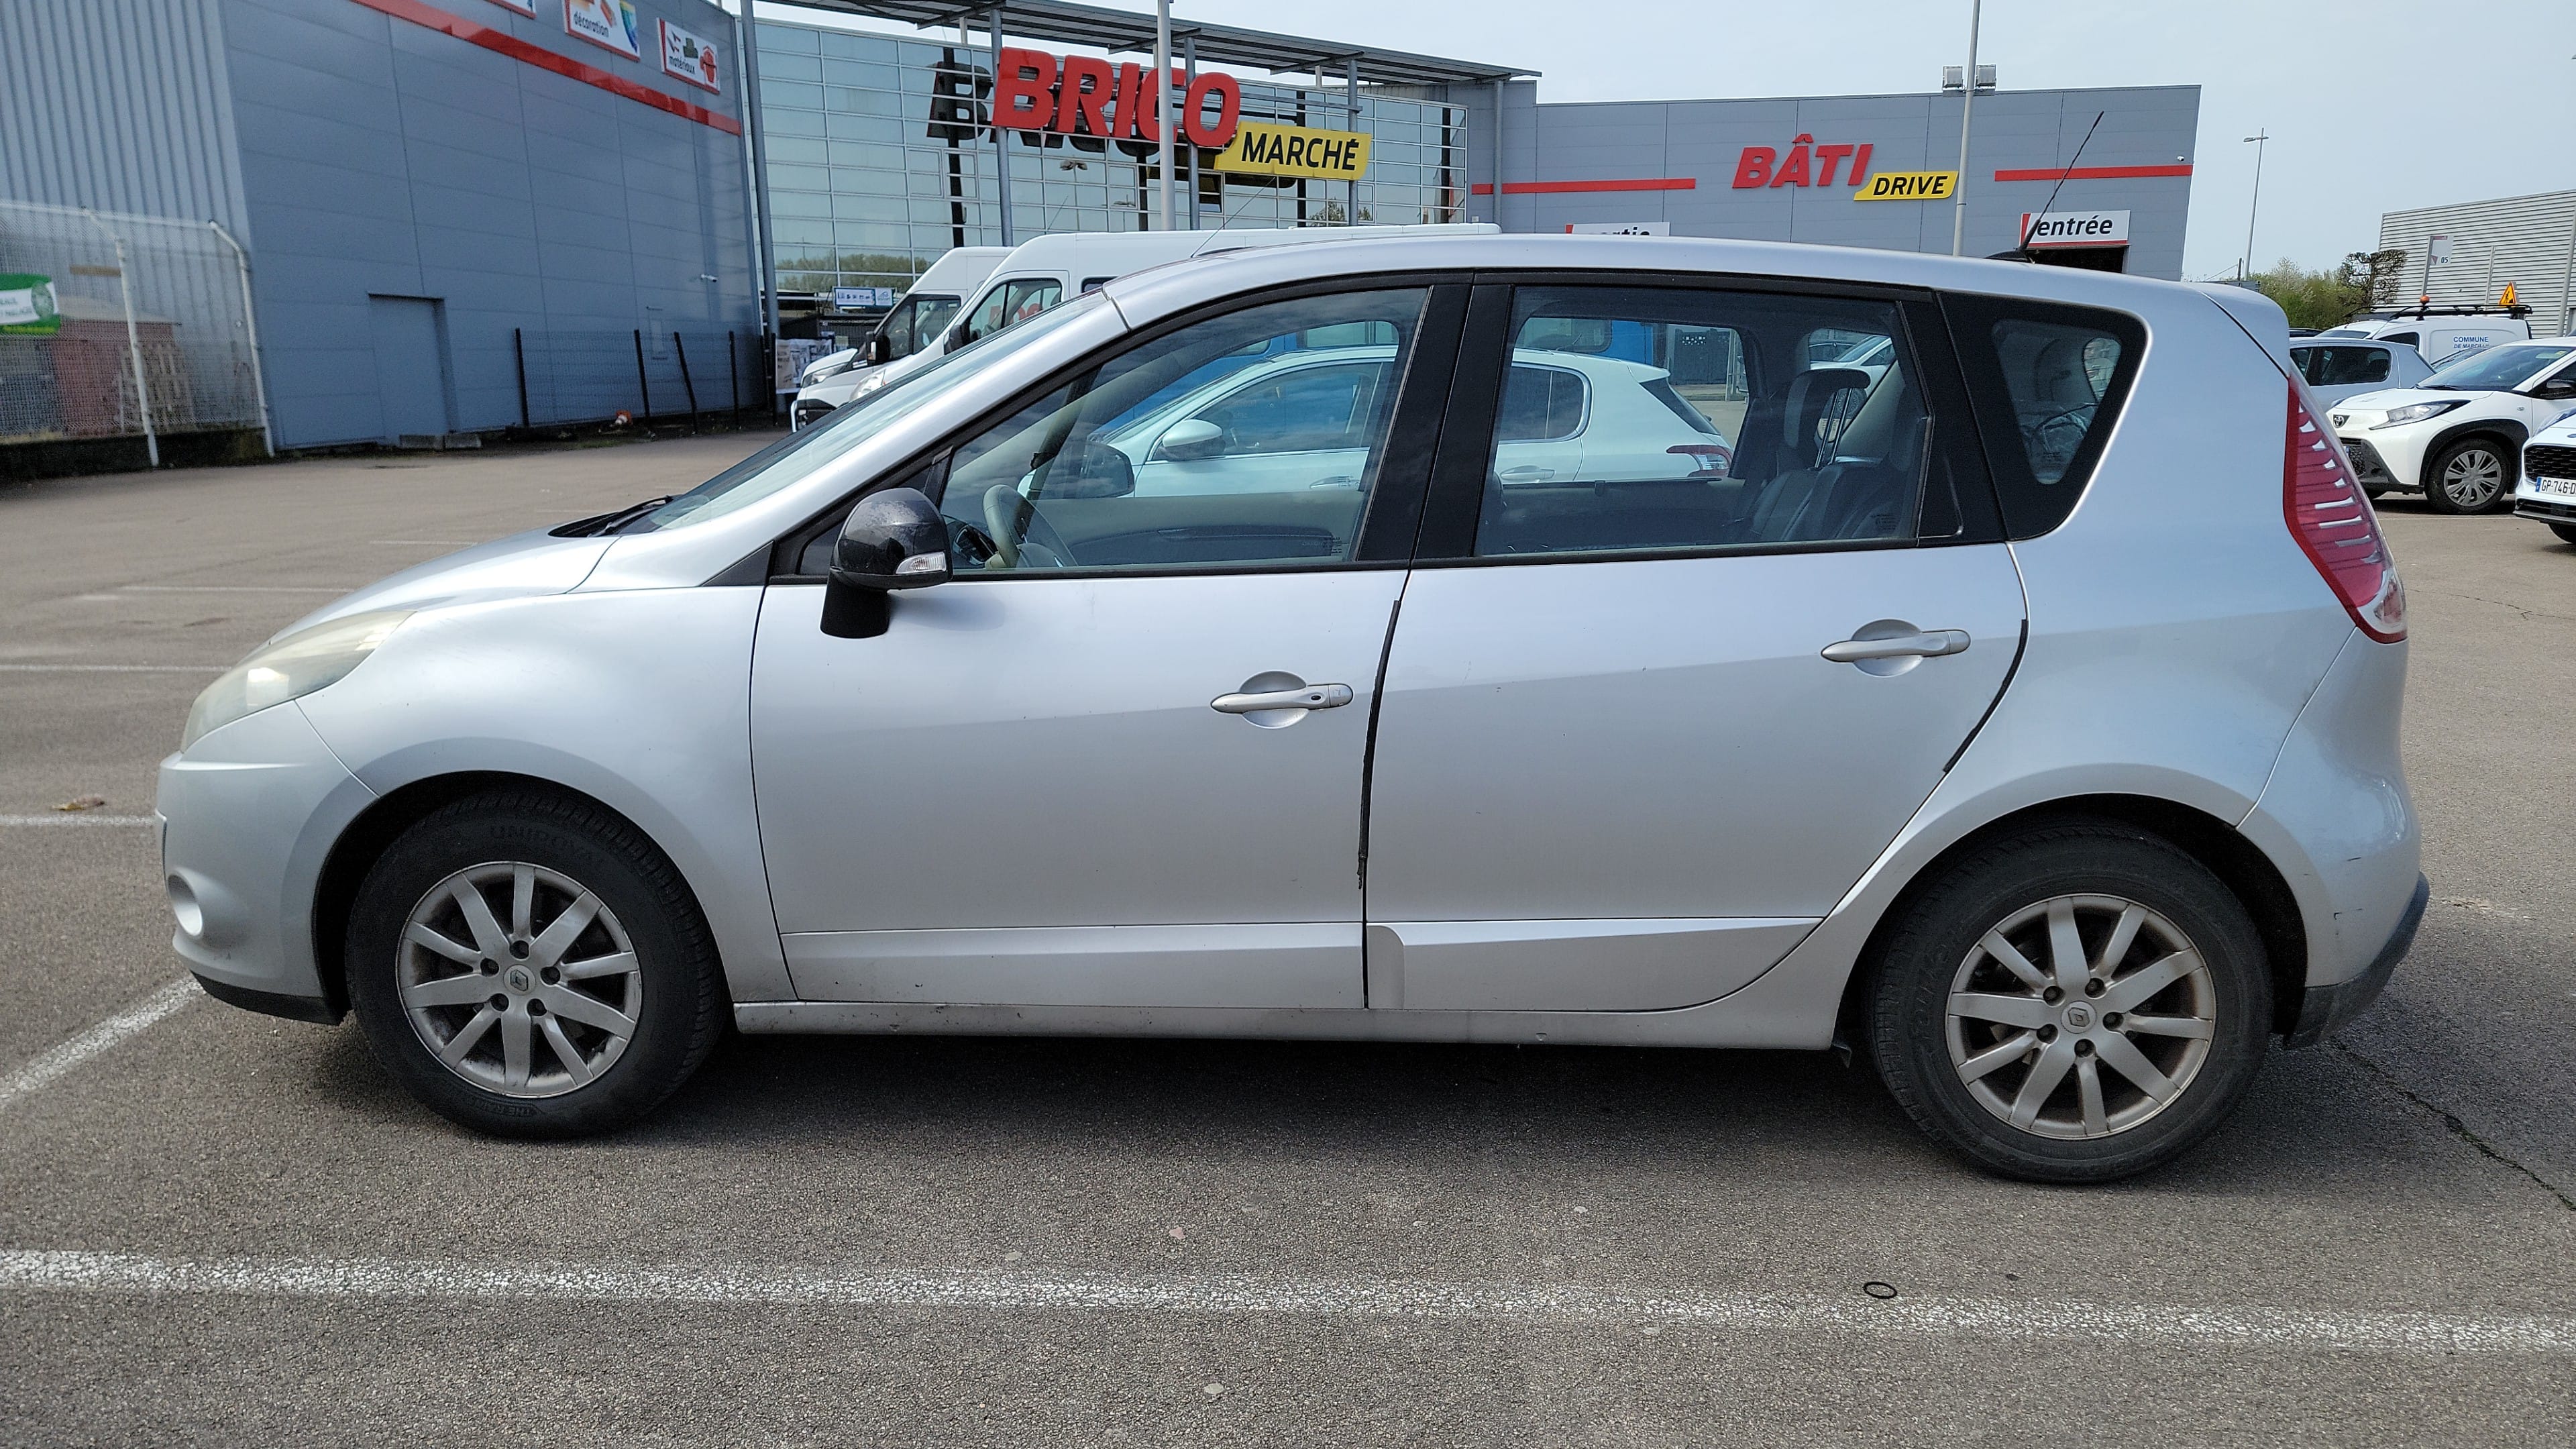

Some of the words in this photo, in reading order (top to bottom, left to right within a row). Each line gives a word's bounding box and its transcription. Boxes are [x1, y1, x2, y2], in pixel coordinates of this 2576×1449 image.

[991, 47, 1240, 147] BRICO
[1242, 131, 1360, 170] MARCHÉ
[1732, 133, 1874, 189] BÂTI
[1873, 176, 1948, 195] DRIVE
[2037, 215, 2113, 236] entrée
[2542, 480, 2576, 494] GP-746-D
